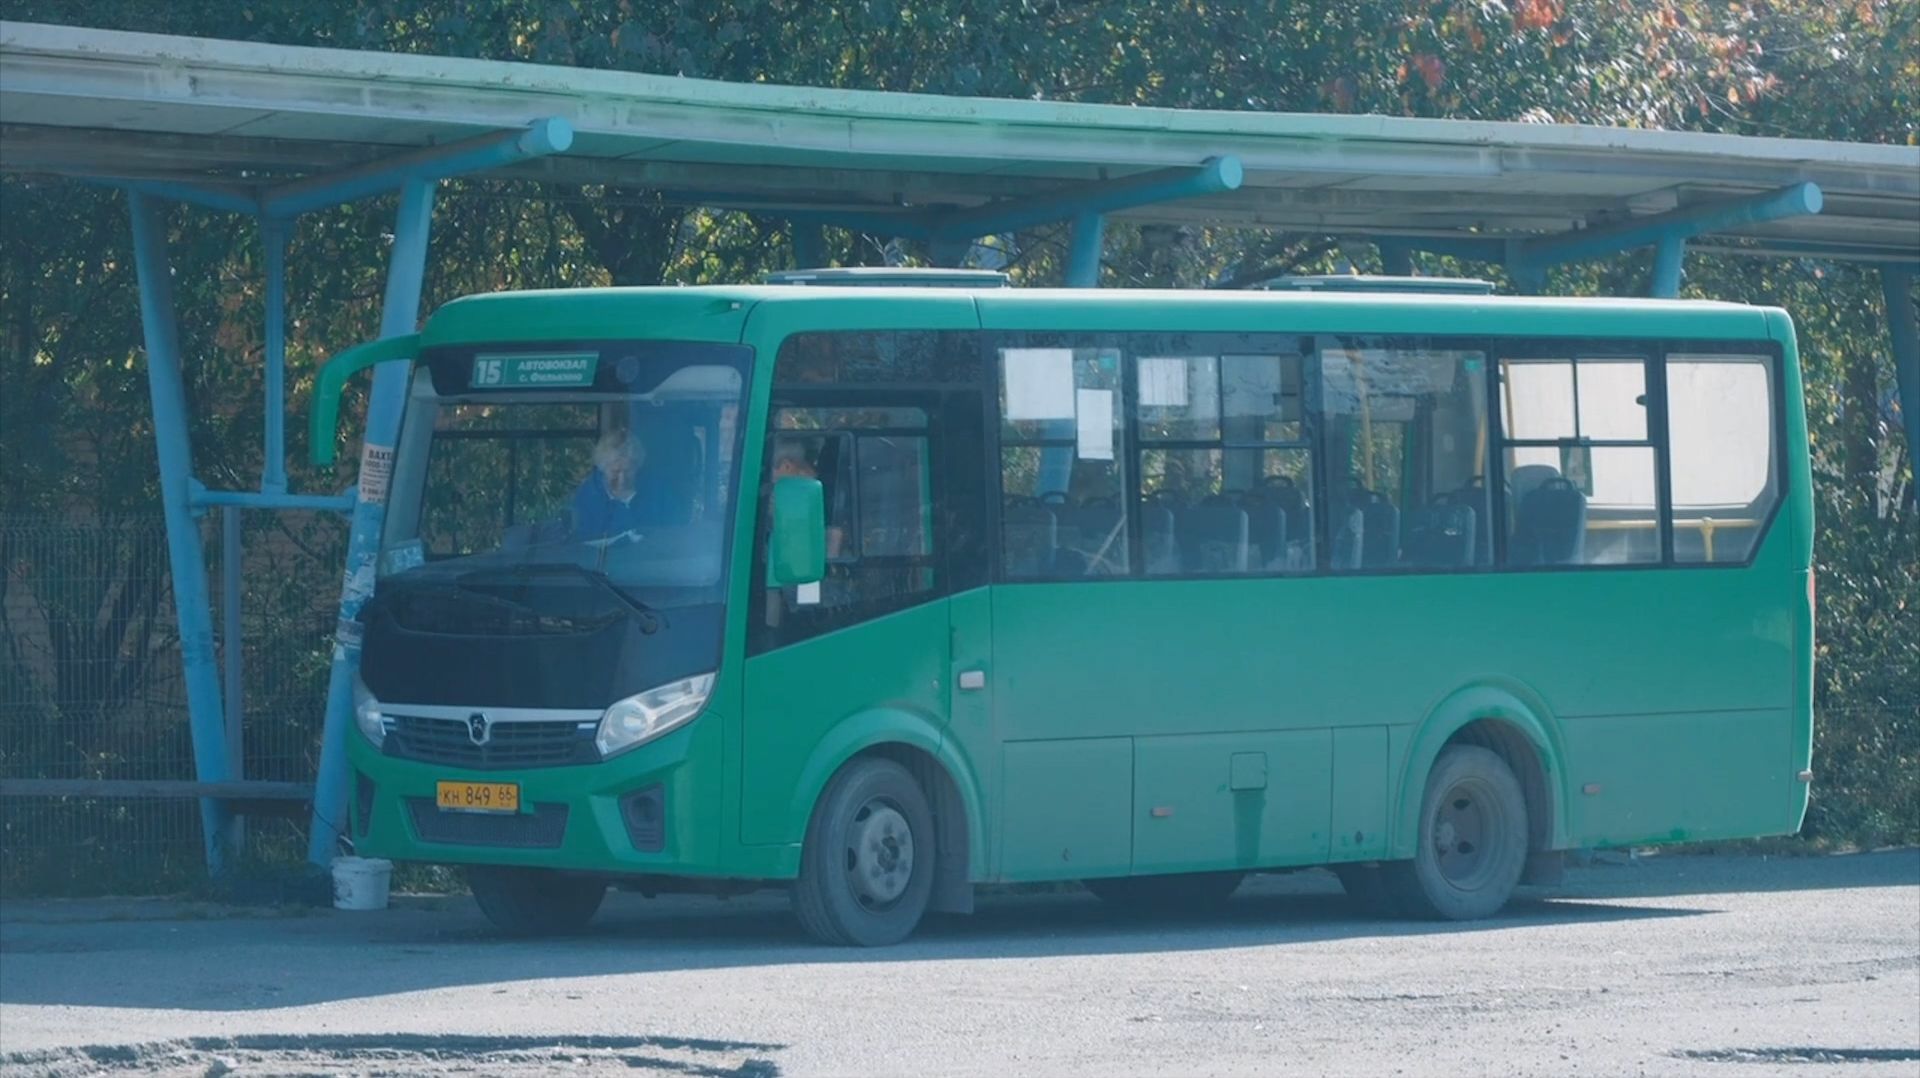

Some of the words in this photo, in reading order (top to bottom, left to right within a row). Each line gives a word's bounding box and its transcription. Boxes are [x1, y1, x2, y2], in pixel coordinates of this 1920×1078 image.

[478, 361, 501, 384] 15
[517, 360, 587, 370] АВТОВОКЗАЛ
[466, 786, 490, 805] 849
[499, 786, 512, 800] 66
